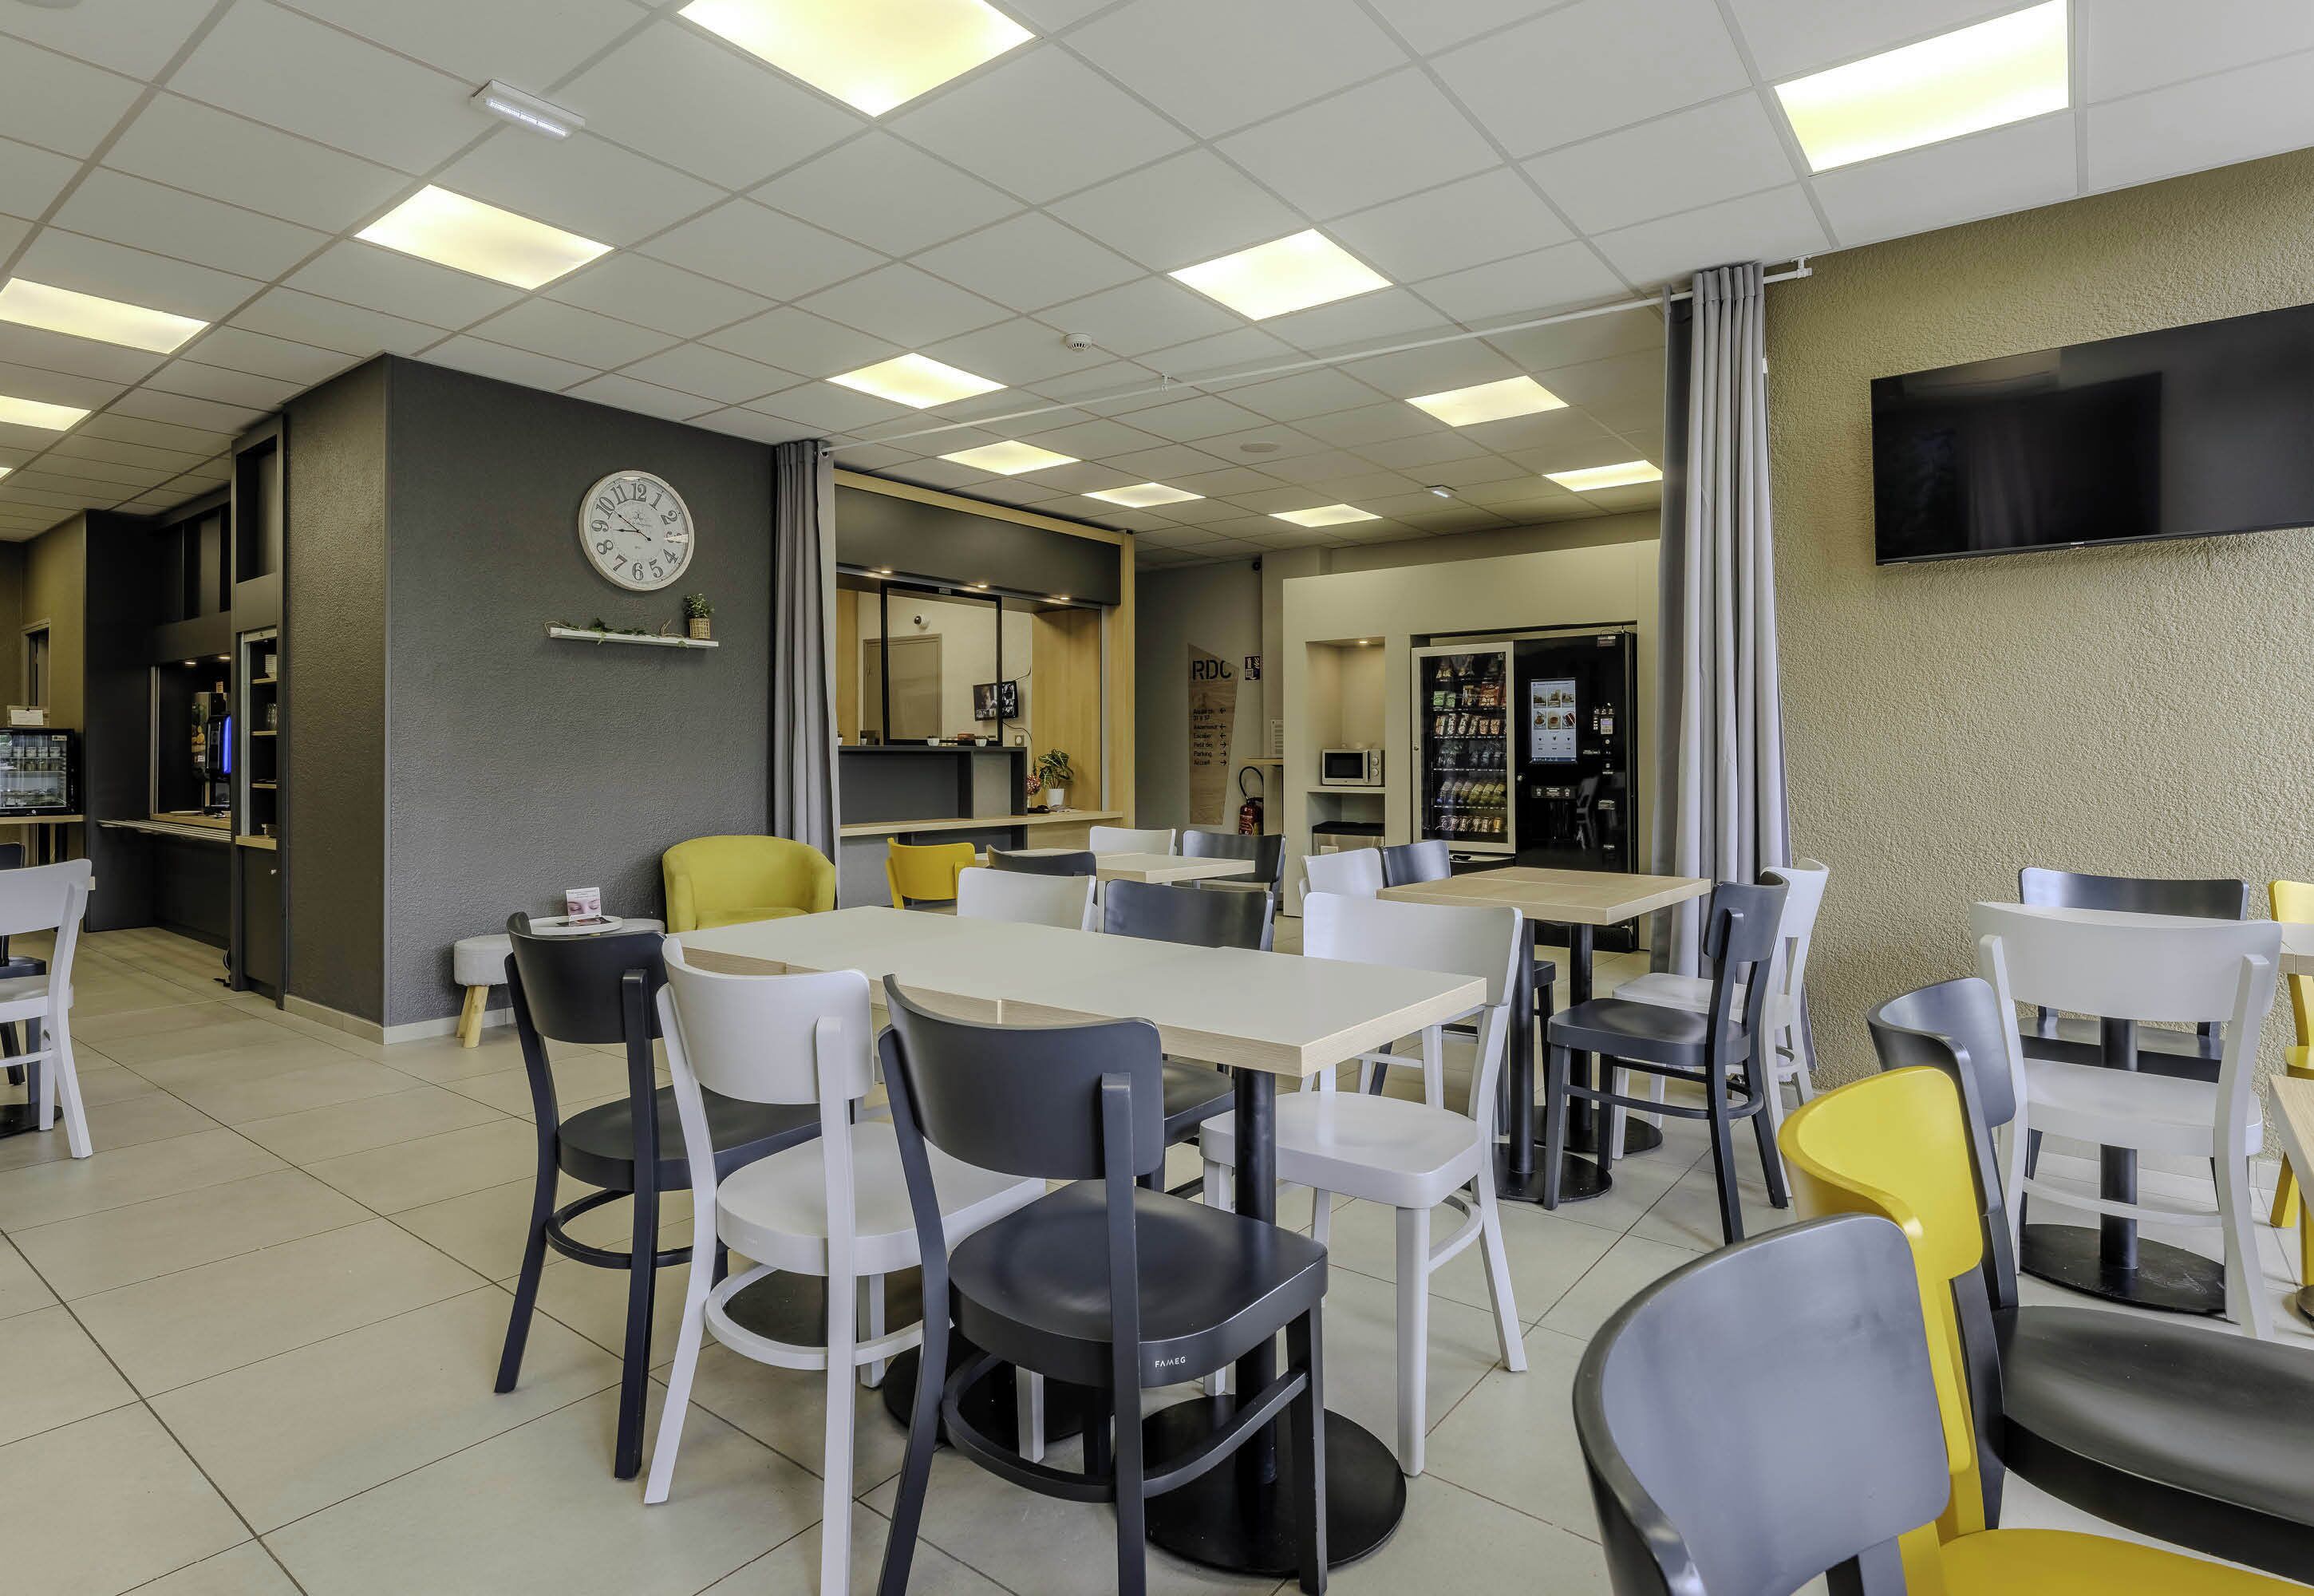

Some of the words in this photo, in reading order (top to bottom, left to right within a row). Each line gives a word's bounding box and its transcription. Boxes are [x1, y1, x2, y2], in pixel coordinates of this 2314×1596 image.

[610, 484, 630, 505] 11
[631, 483, 647, 503] 12
[649, 492, 662, 511] 1
[595, 496, 615, 520] 10
[661, 510, 678, 525] 2
[591, 519, 609, 532] 9
[596, 539, 614, 555] 8
[663, 548, 679, 564] 4
[613, 554, 628, 572] 7
[632, 562, 644, 581] 6
[649, 559, 664, 578] 5
[1192, 659, 1232, 680] RDC
[1155, 1356, 1187, 1369] FAMEG
